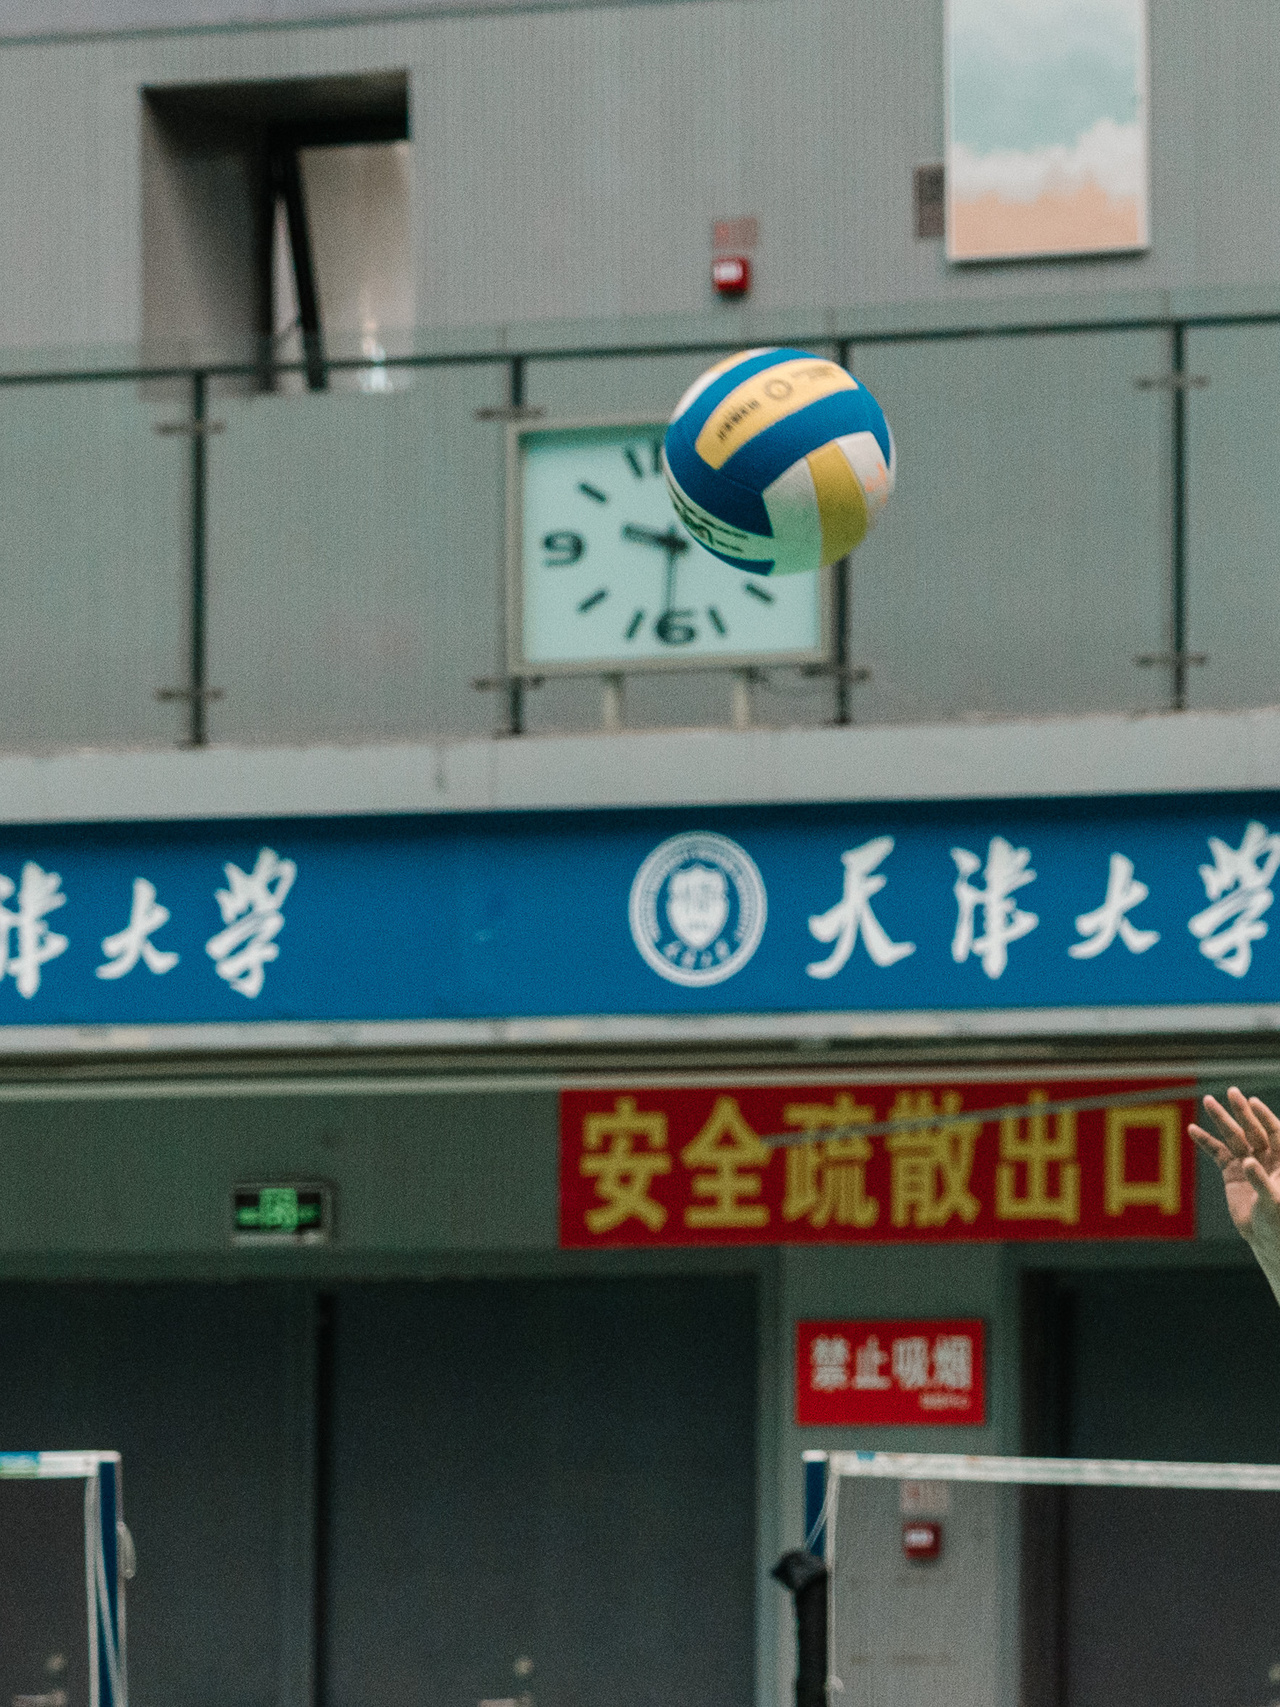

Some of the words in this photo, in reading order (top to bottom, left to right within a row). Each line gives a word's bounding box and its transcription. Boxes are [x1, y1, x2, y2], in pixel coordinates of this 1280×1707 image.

[542, 531, 586, 568] 9
[653, 611, 698, 646] 6
[580, 1090, 1184, 1234] 安全疏散出口
[811, 1334, 972, 1391] 禁止吸烟
